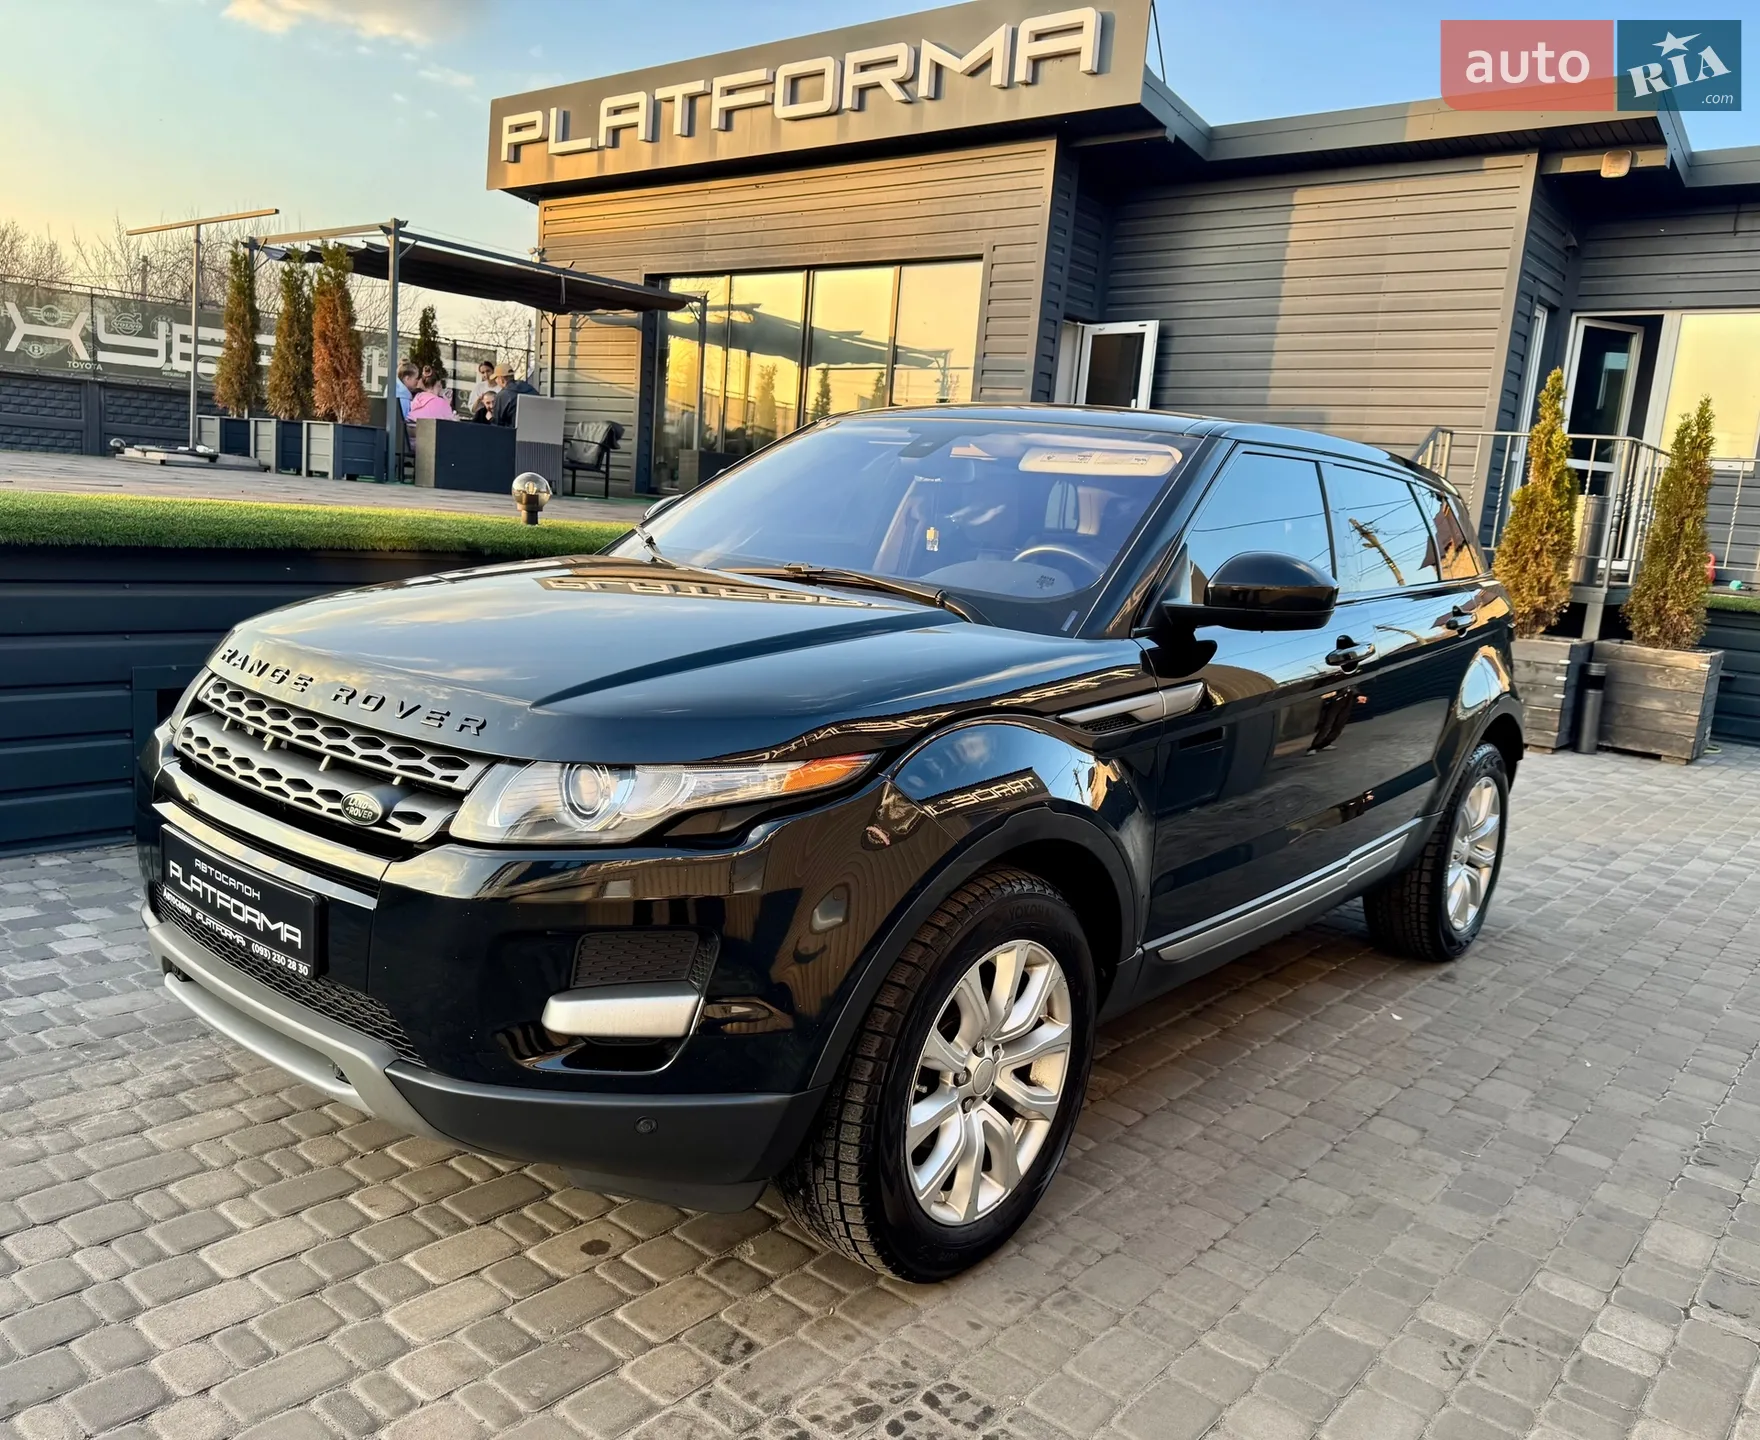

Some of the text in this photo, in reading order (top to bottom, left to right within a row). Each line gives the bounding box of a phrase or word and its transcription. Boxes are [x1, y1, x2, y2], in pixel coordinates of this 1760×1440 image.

[501, 7, 1103, 163] PLATFORMA
[113, 321, 141, 331] VOLVO
[67, 361, 103, 371] TOYOTA
[219, 648, 488, 736] RANGE ROVER
[349, 797, 369, 809] LAND
[349, 807, 373, 820] ROVER
[169, 860, 302, 949] PLATFORMA
[251, 942, 271, 960] (093)
[271, 952, 286, 966] 230
[298, 964, 308, 976] 30
